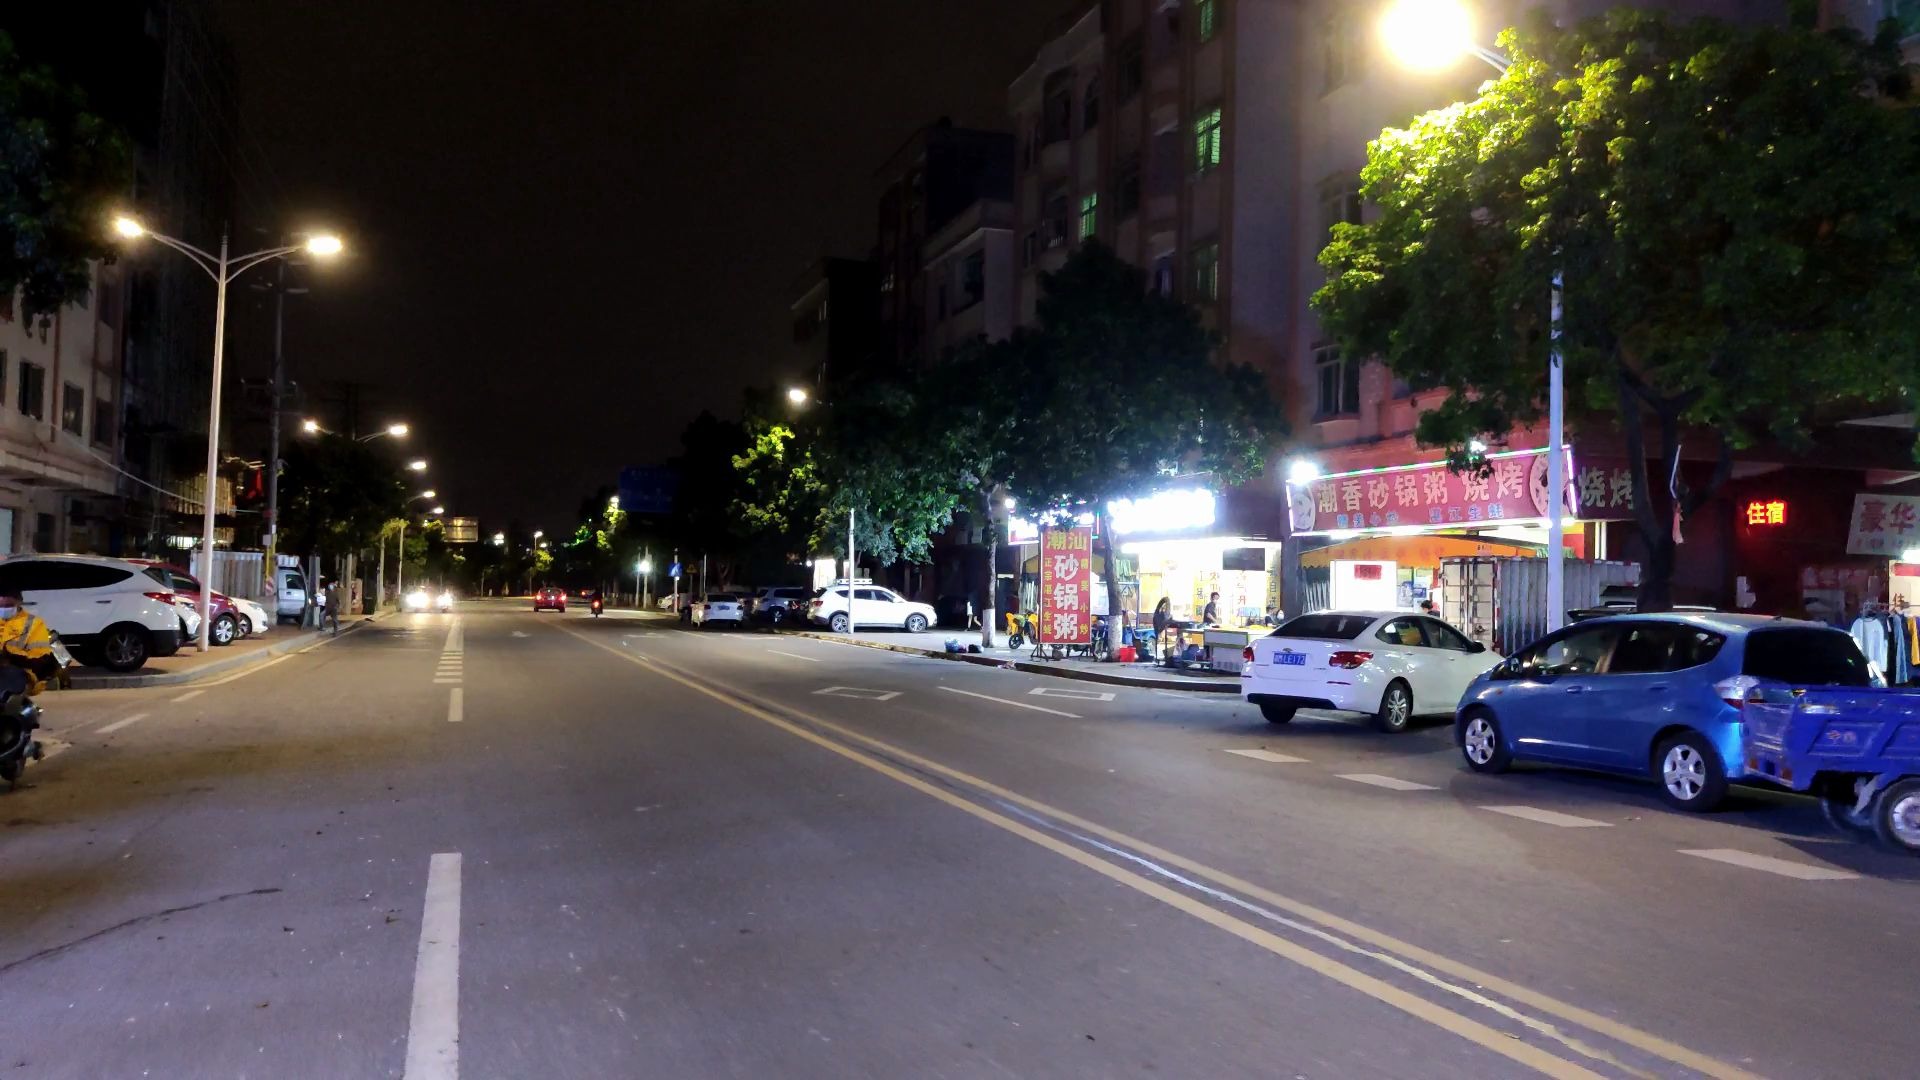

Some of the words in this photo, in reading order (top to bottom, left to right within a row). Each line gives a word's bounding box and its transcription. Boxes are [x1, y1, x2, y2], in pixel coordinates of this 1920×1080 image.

[1318, 470, 1448, 513] 潮香砂锅粥
[1462, 461, 1524, 502] 烧烤
[1747, 501, 1785, 524] 住宿
[1053, 553, 1079, 640] 砂锅粥
